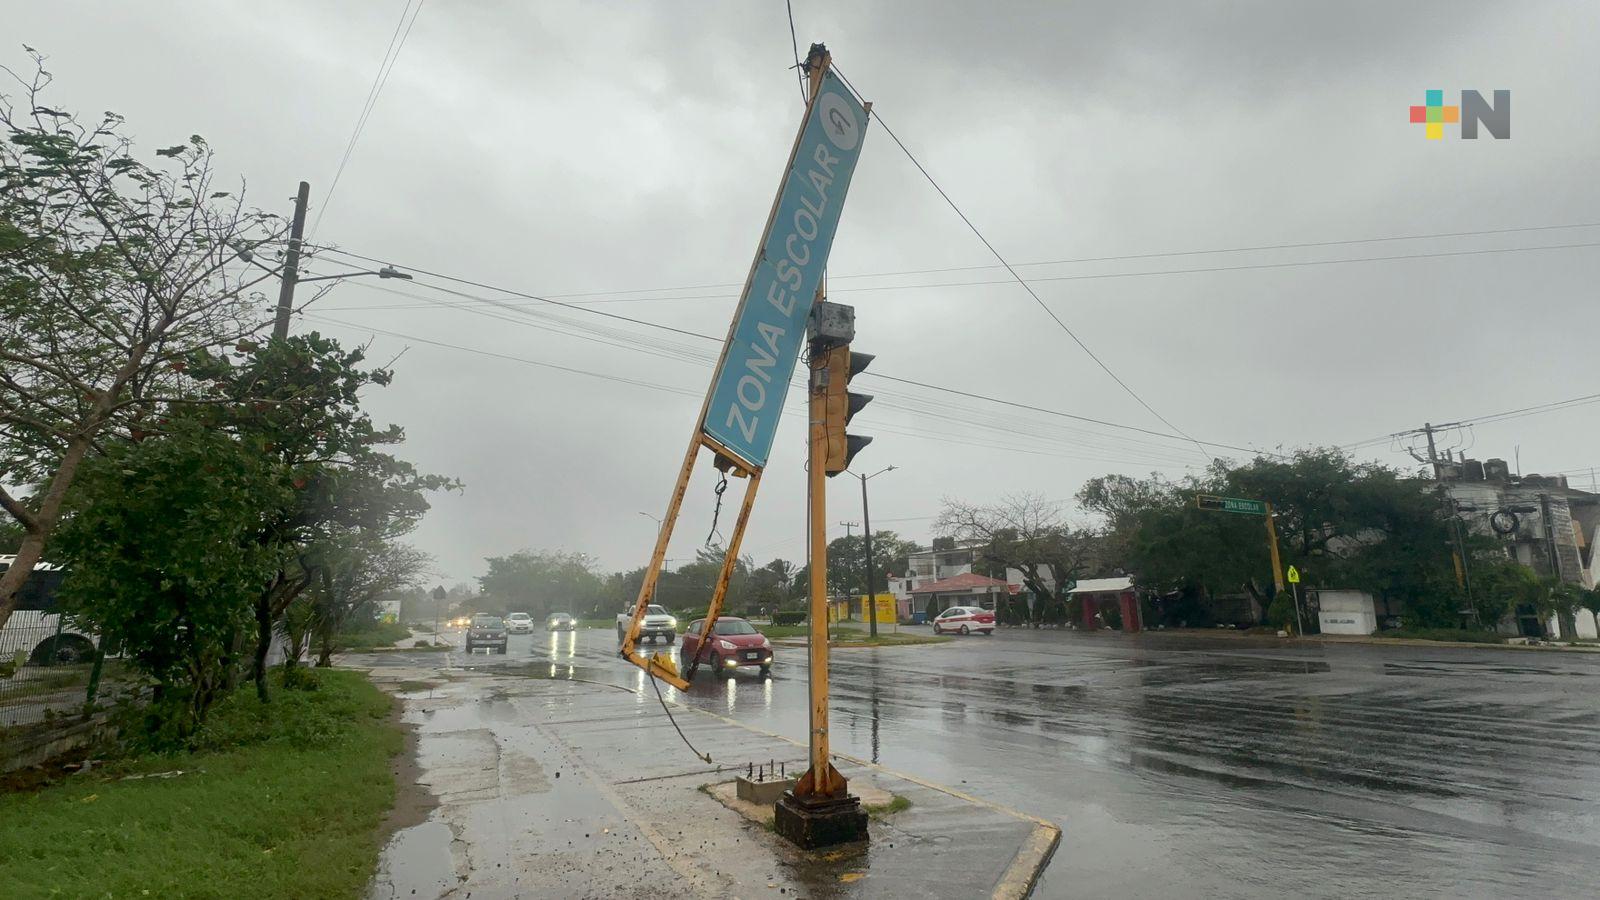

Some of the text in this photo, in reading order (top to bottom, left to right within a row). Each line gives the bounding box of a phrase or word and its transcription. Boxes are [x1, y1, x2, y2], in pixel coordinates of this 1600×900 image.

[725, 143, 840, 444] ZONA ESCOLAR
[1224, 500, 1238, 509] ZONA
